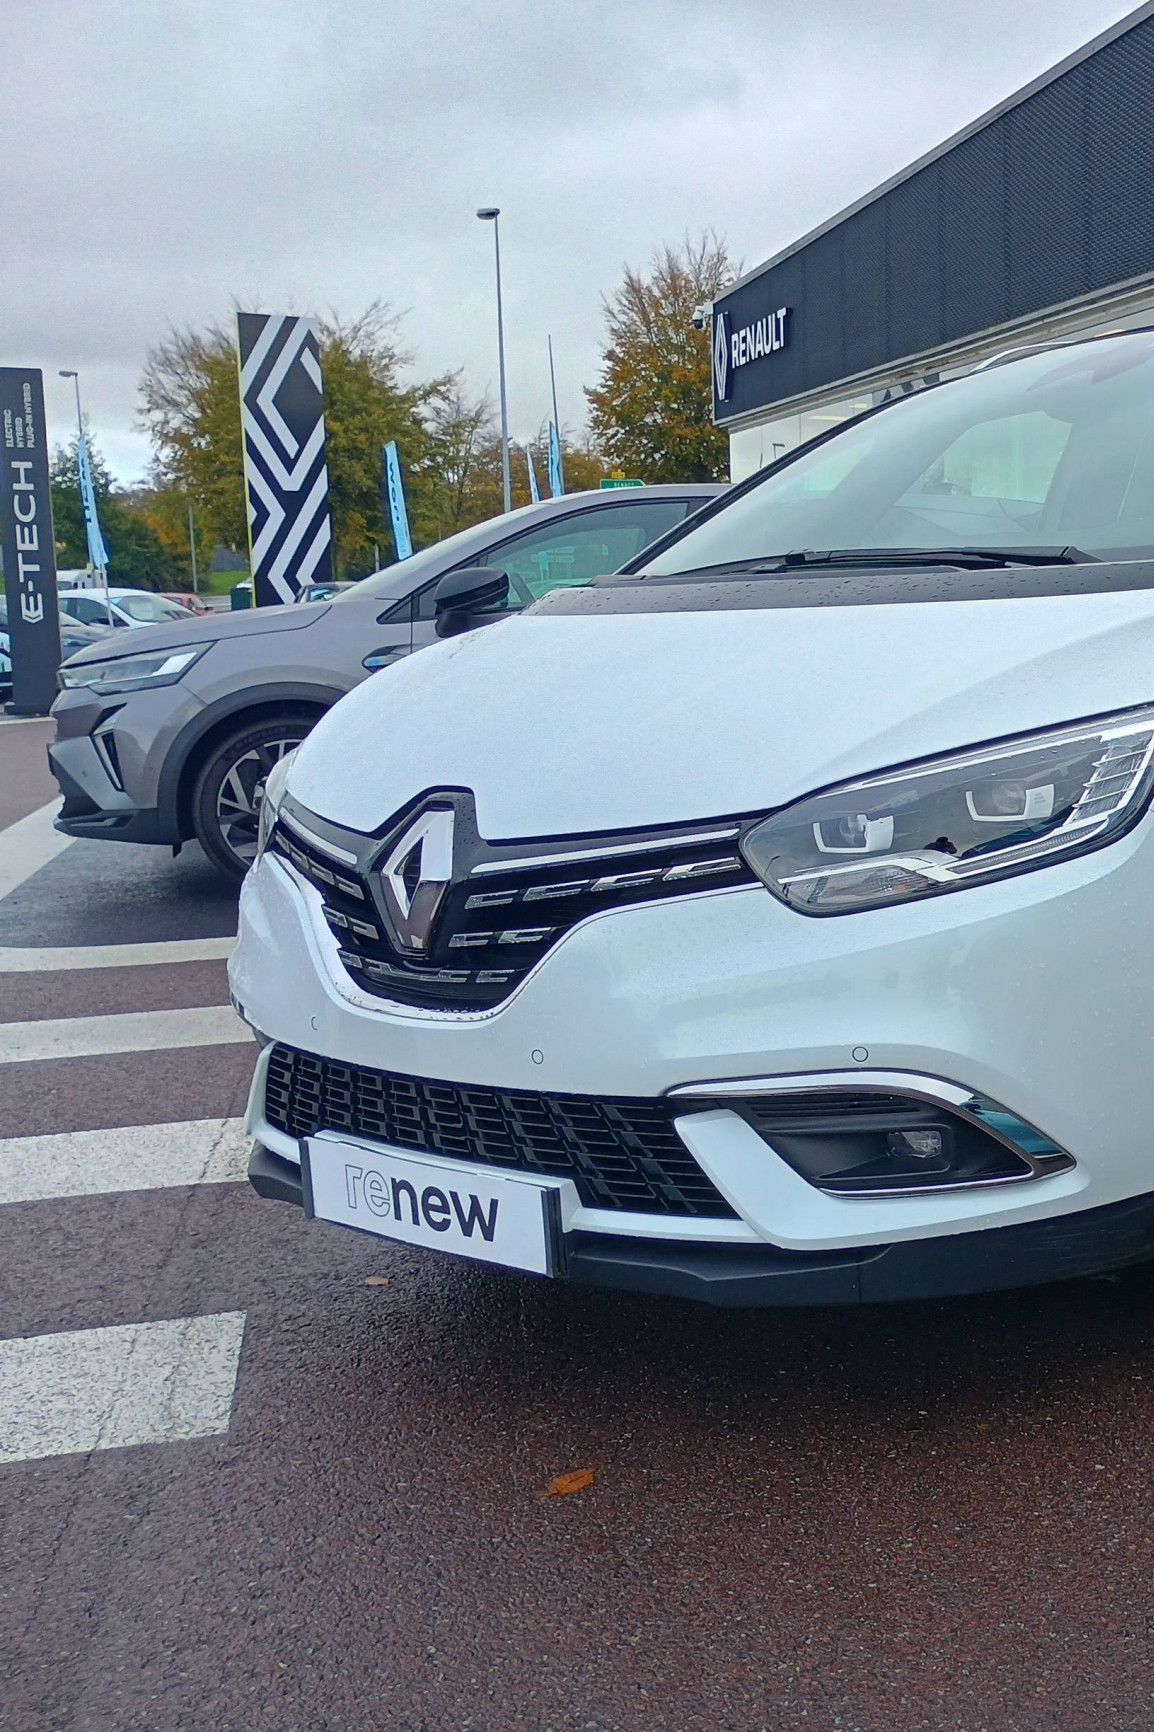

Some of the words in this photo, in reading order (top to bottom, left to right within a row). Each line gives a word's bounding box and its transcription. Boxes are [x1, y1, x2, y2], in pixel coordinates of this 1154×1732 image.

[731, 306, 787, 370] RENAULT
[23, 382, 32, 413] HYBRID
[15, 416, 24, 448] HYBRID
[26, 414, 35, 449] PLUG-IN
[11, 460, 44, 624] E-TECH
[345, 1164, 499, 1242] renew
